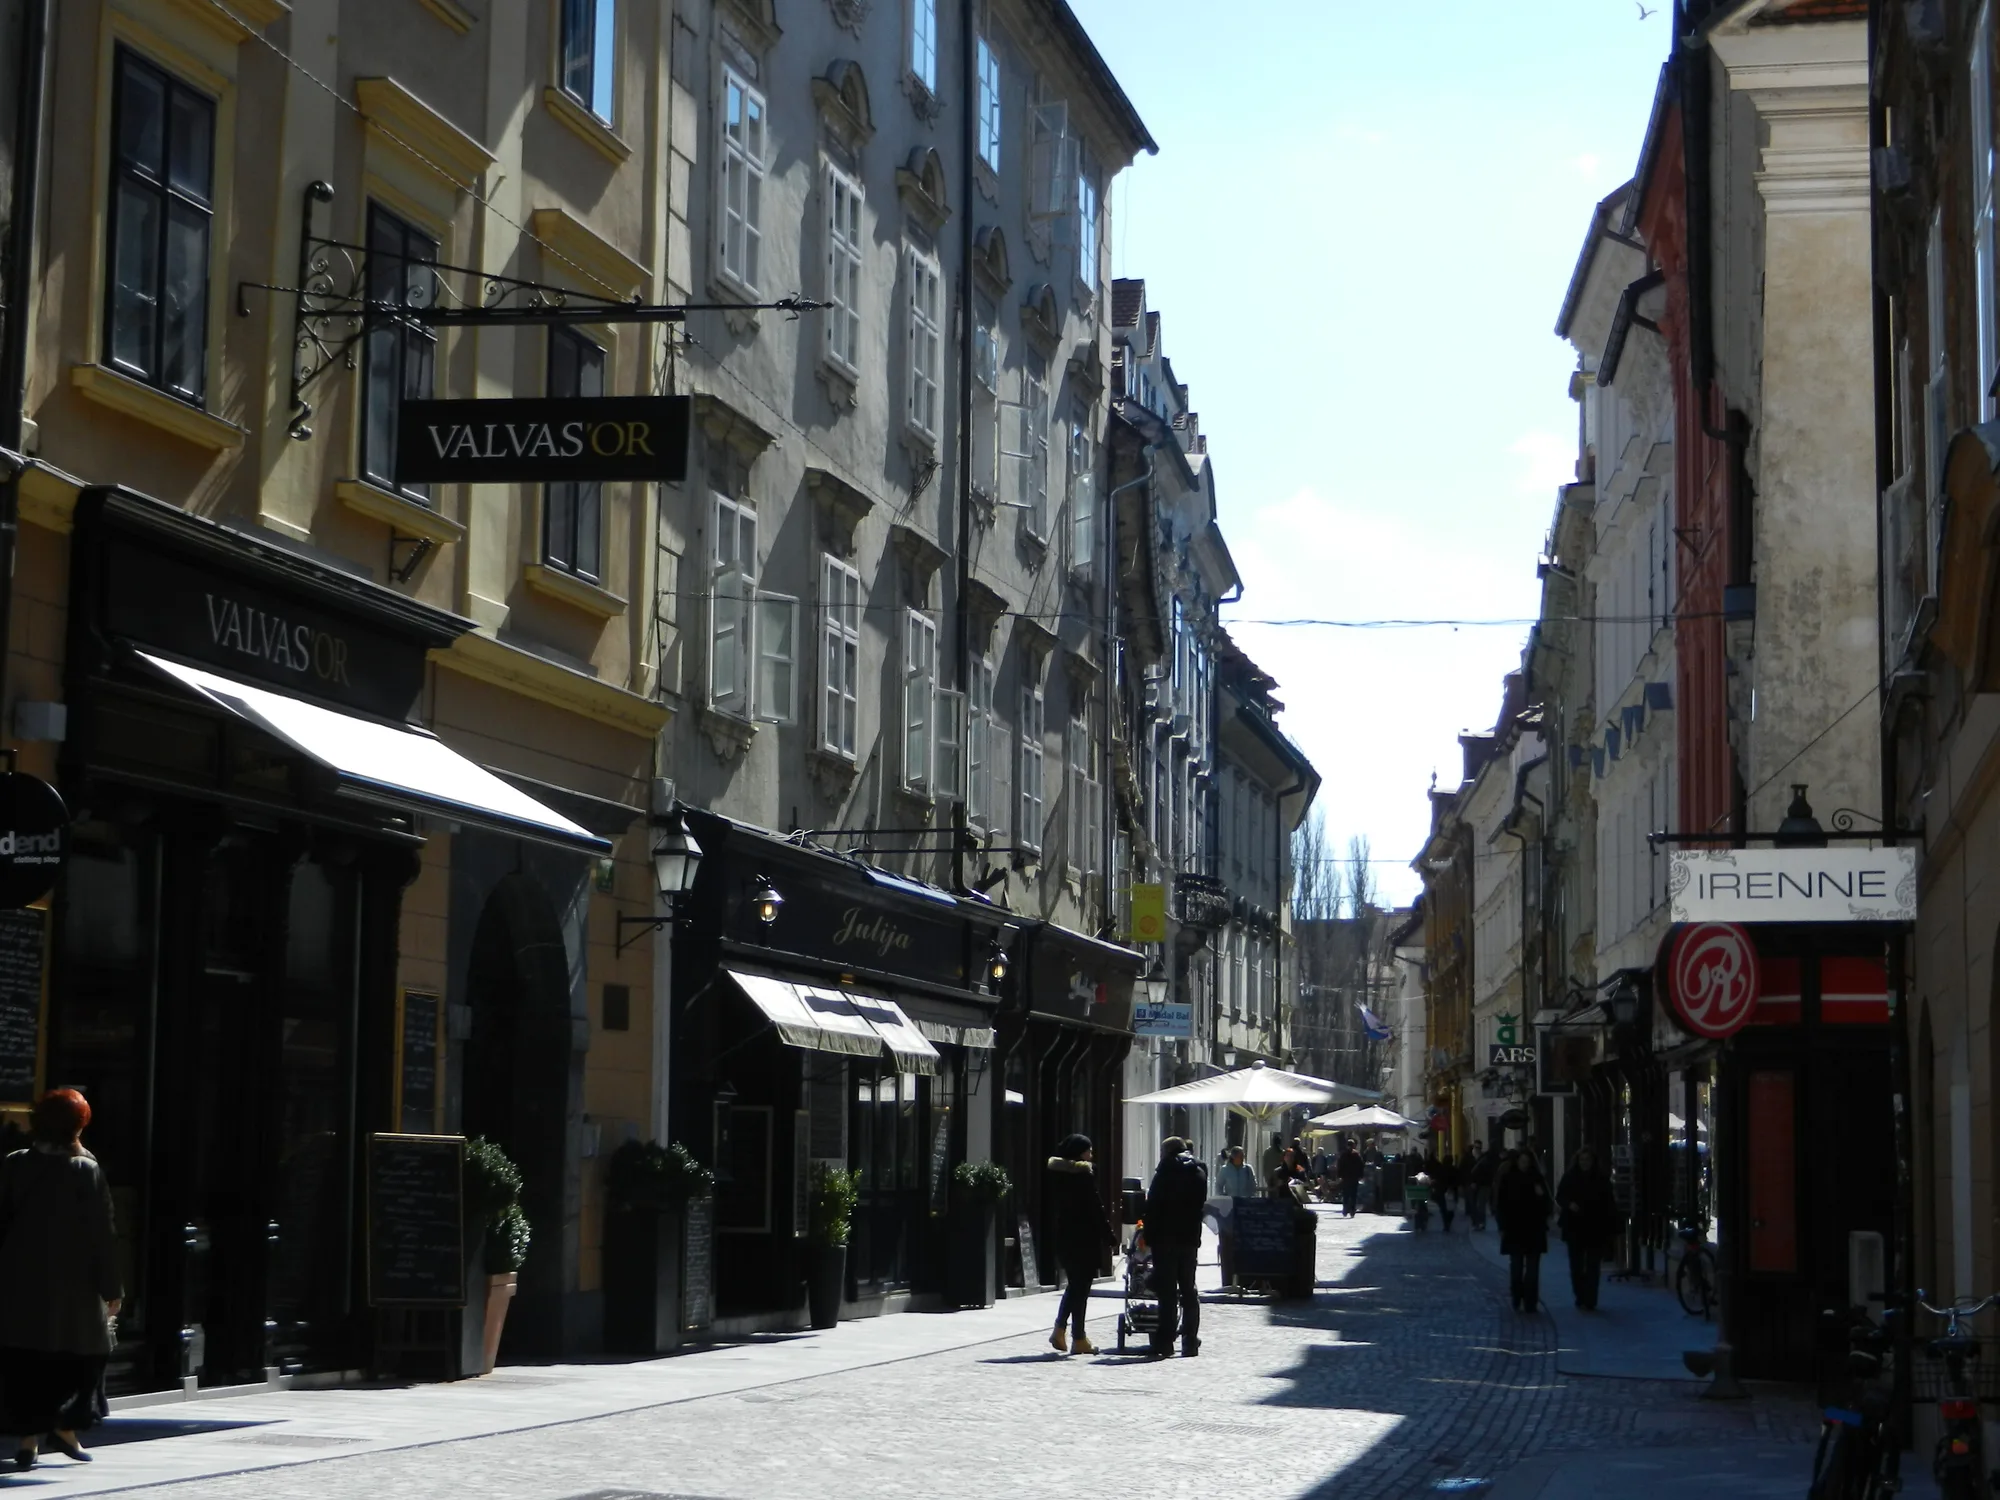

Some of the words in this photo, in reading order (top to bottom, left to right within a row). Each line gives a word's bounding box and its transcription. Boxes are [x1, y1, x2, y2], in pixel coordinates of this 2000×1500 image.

[428, 422, 655, 459] VALVAS'OR
[206, 593, 351, 687] VALVAS'OR
[13, 856, 42, 864] clothing
[43, 856, 60, 864] shop
[1699, 870, 1887, 900] IRENNE
[833, 907, 913, 957] Julija
[1493, 1047, 1536, 1063] ARS
